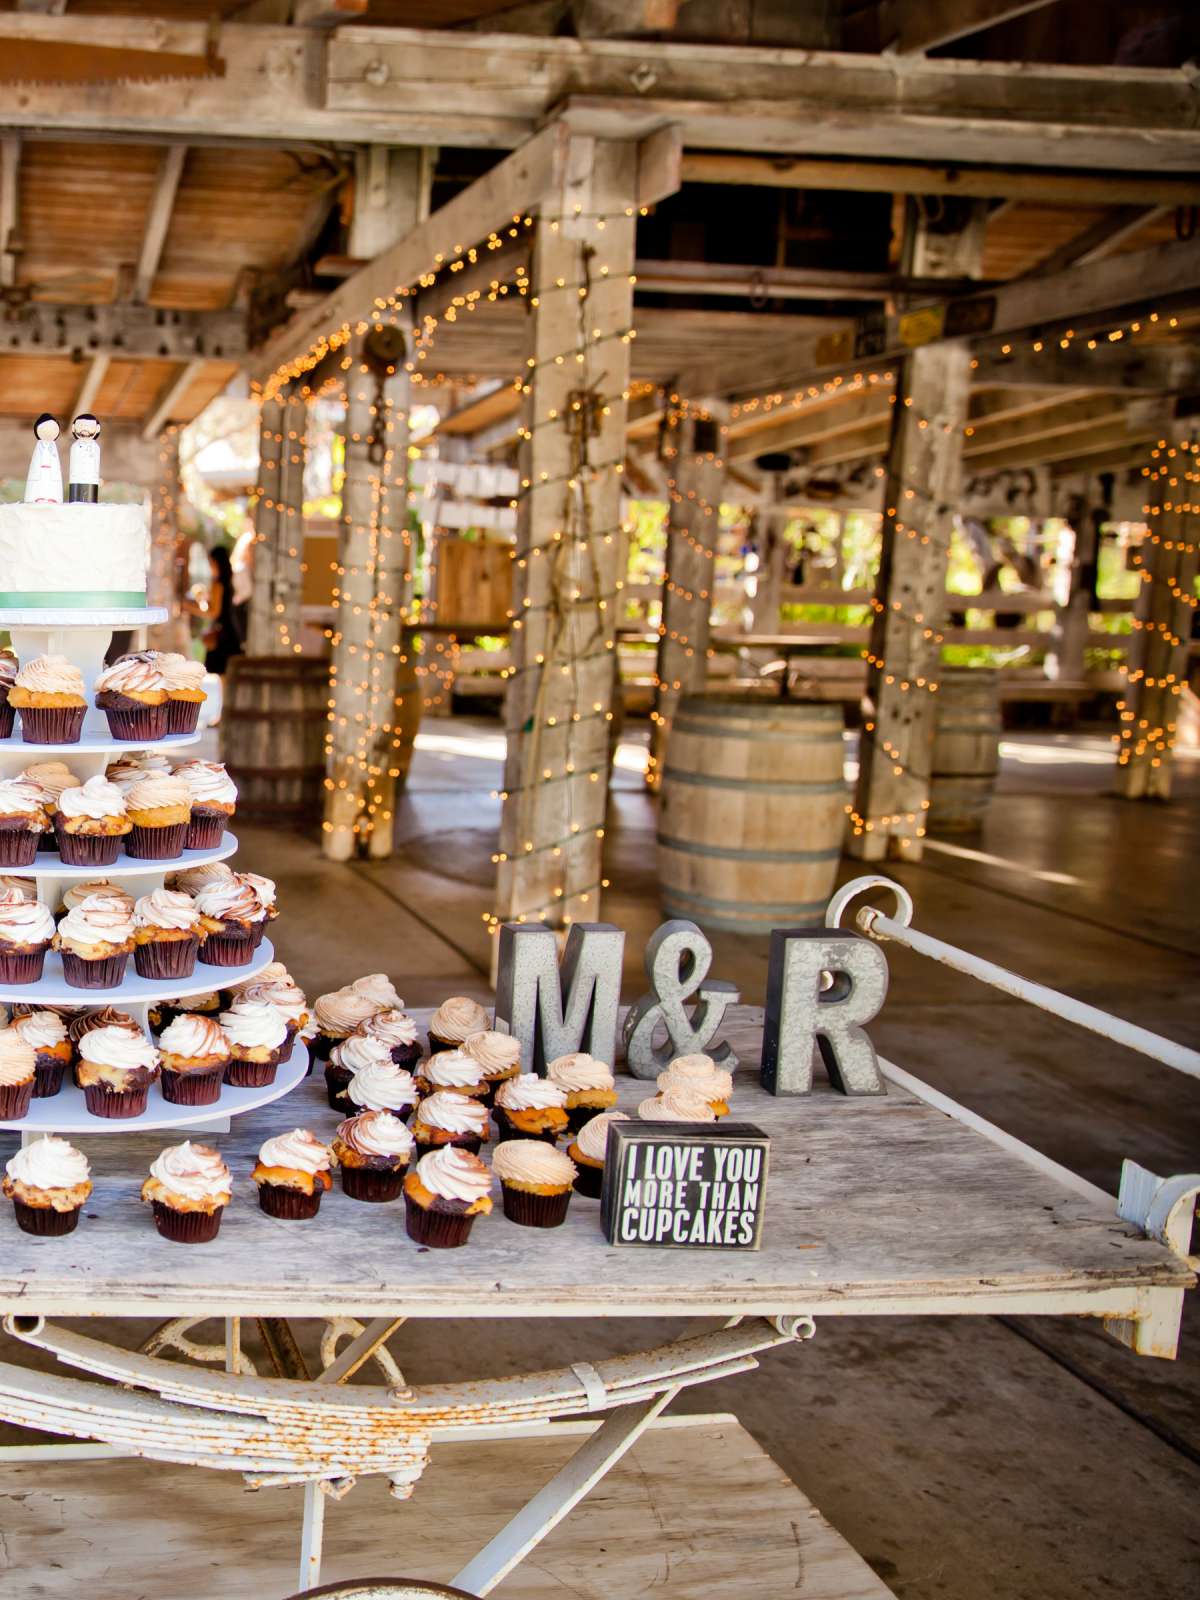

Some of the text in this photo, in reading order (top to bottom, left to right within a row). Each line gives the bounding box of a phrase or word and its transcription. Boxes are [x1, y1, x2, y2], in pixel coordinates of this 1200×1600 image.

[498, 920, 889, 1096] M & R
[627, 1145, 762, 1183] I LOVE YOU
[623, 1179, 759, 1211] MORE THAN
[621, 1207, 755, 1245] CUPCAKES
